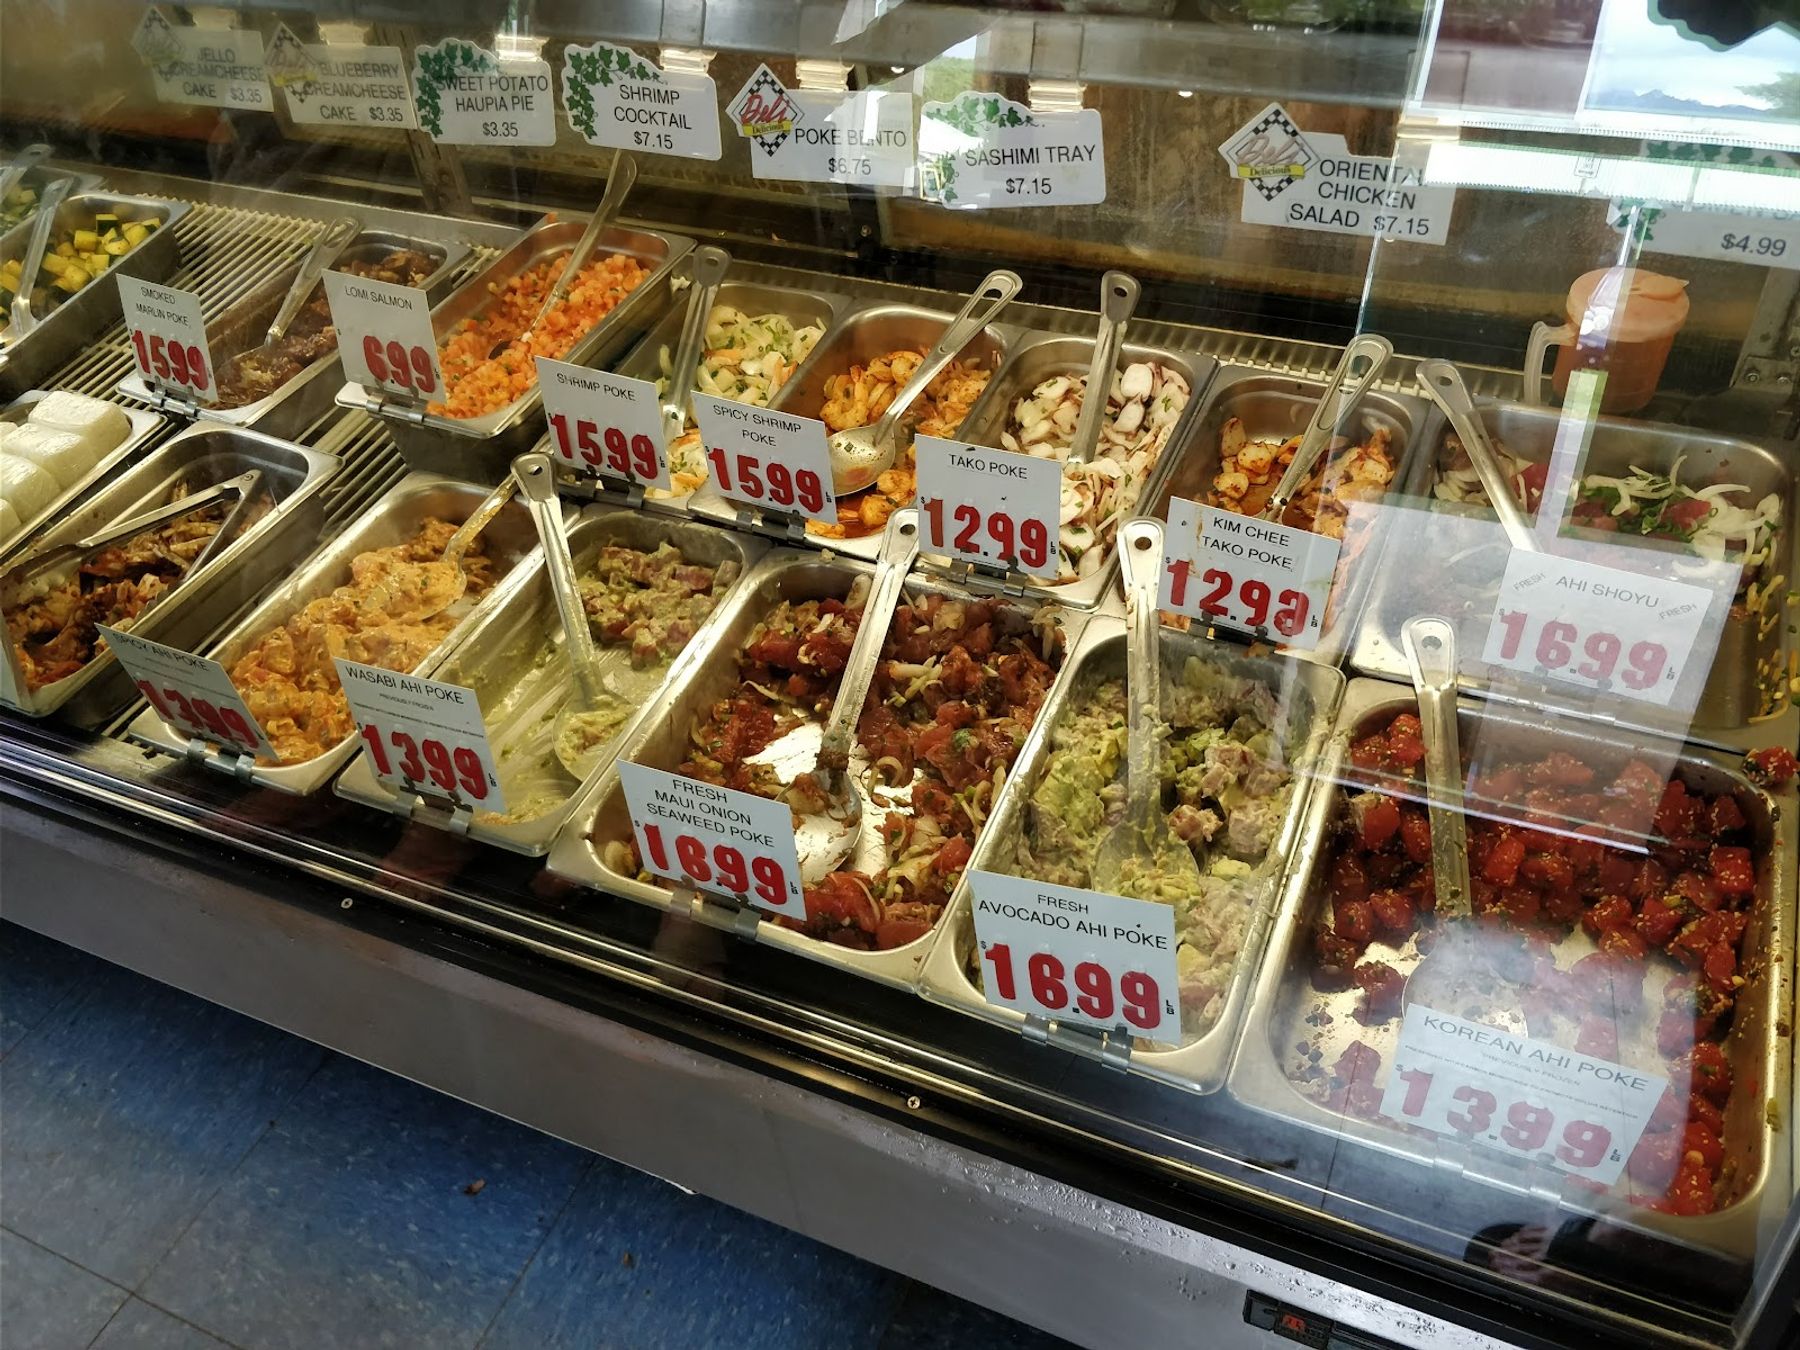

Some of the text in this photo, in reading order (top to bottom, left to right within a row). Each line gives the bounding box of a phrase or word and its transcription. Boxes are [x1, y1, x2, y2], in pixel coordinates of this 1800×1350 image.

[198, 48, 236, 63] JELLO
[321, 62, 400, 78] BLUEBERRY
[182, 82, 262, 103] CAKE $3.35
[305, 80, 406, 100] CREAMCHEESE
[489, 76, 548, 92] POTATO
[620, 84, 680, 106] SHRIMP
[320, 105, 403, 122] CAKE $3.35
[456, 96, 534, 112] HAUPIA PIE
[741, 94, 790, 124] Deli
[614, 106, 692, 130] COCKTAIL
[482, 122, 518, 138] $3.35
[634, 131, 673, 150] $7.15
[796, 128, 841, 146] POKE
[966, 144, 1096, 166] SASHIMI TRAY
[828, 157, 872, 176] $6.75
[1006, 177, 1052, 196] $7.15
[1318, 182, 1416, 210] CHICKEN
[1290, 204, 1430, 236] SALAD $7.15
[1721, 232, 1786, 257] $4.99
[140, 286, 176, 305] SMOKED
[345, 286, 412, 311] LOMI SALMON
[136, 304, 189, 326] MARLIN POKE
[556, 372, 636, 402] SHRIMP POKE
[713, 404, 802, 434] SPICY SHRIMP
[742, 429, 777, 447] POKE
[948, 454, 1028, 480] TAKO POKE
[1213, 516, 1290, 547] KIM CHEE
[1202, 536, 1292, 570] TAKO POKE
[1514, 572, 1546, 592] FRESH
[1555, 576, 1660, 608] AHI SHOYU
[1658, 602, 1697, 620] FRESH
[152, 646, 172, 659] AHI
[174, 653, 210, 672] POKE
[346, 666, 465, 704] WASABI AHI POKE
[672, 778, 728, 804] FRESH
[654, 790, 752, 826] MAUI ONION
[646, 802, 775, 848] SEAWEED POKE
[1038, 894, 1088, 914] FRESH
[978, 900, 1168, 950] AVOCADO AHI POKE
[1423, 1015, 1524, 1055] KOREAN
[1528, 1048, 1571, 1069] AHI
[1577, 1061, 1648, 1092] POKE
